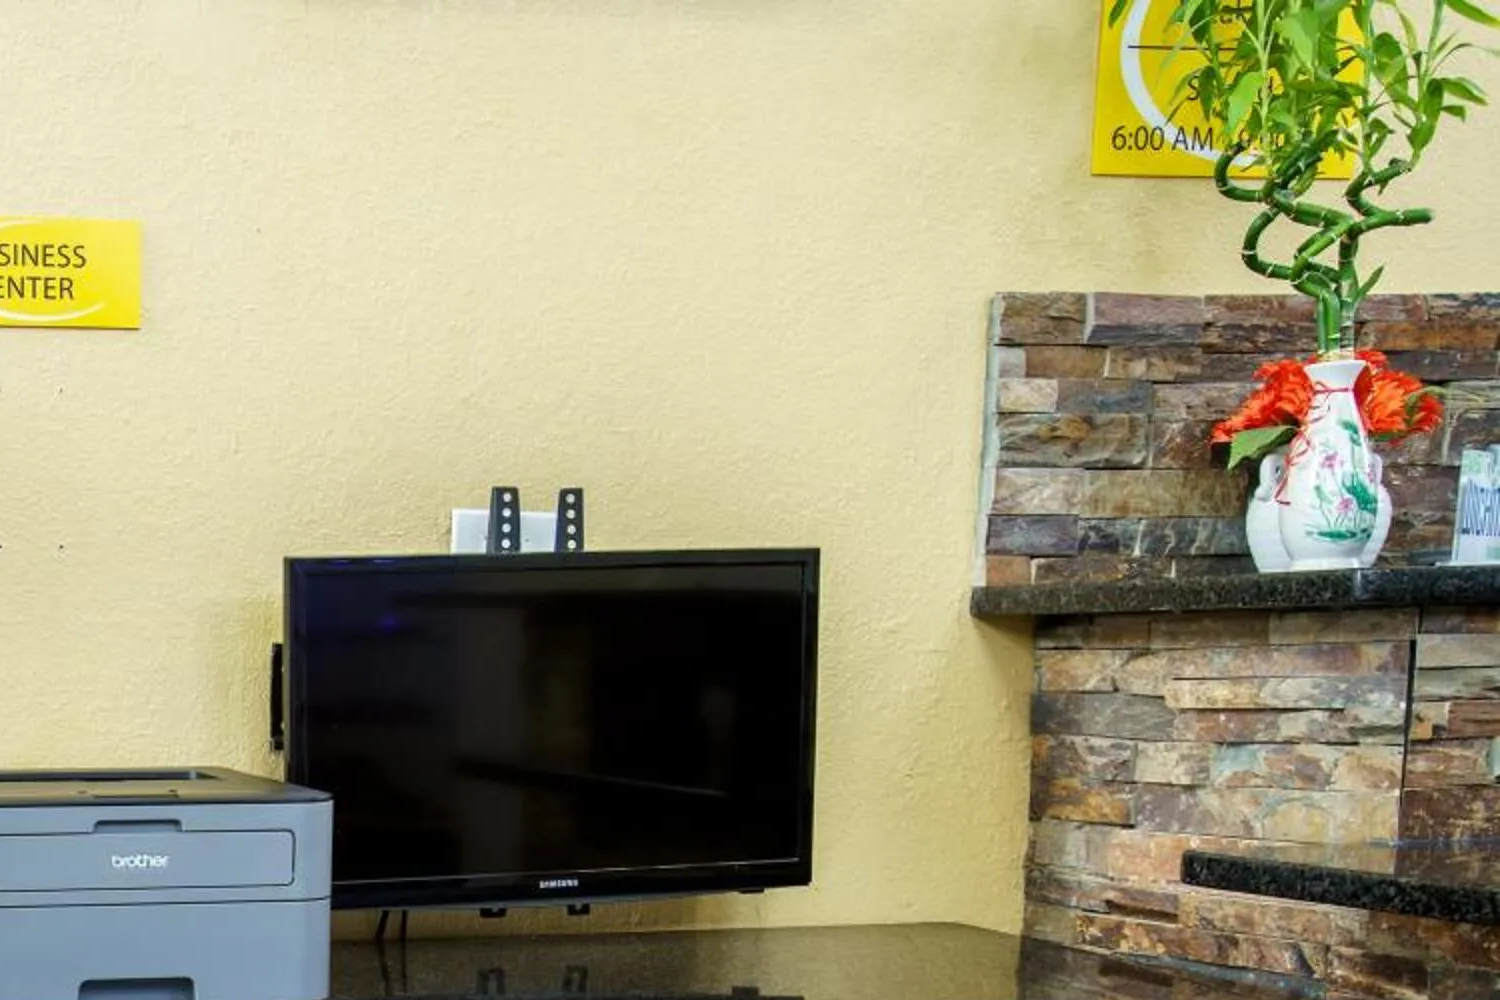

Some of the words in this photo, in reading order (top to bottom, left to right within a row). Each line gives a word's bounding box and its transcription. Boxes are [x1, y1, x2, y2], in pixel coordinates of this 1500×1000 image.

[1111, 125, 1164, 151] 6:00
[1172, 127, 1213, 151] AM
[111, 854, 169, 868] brother
